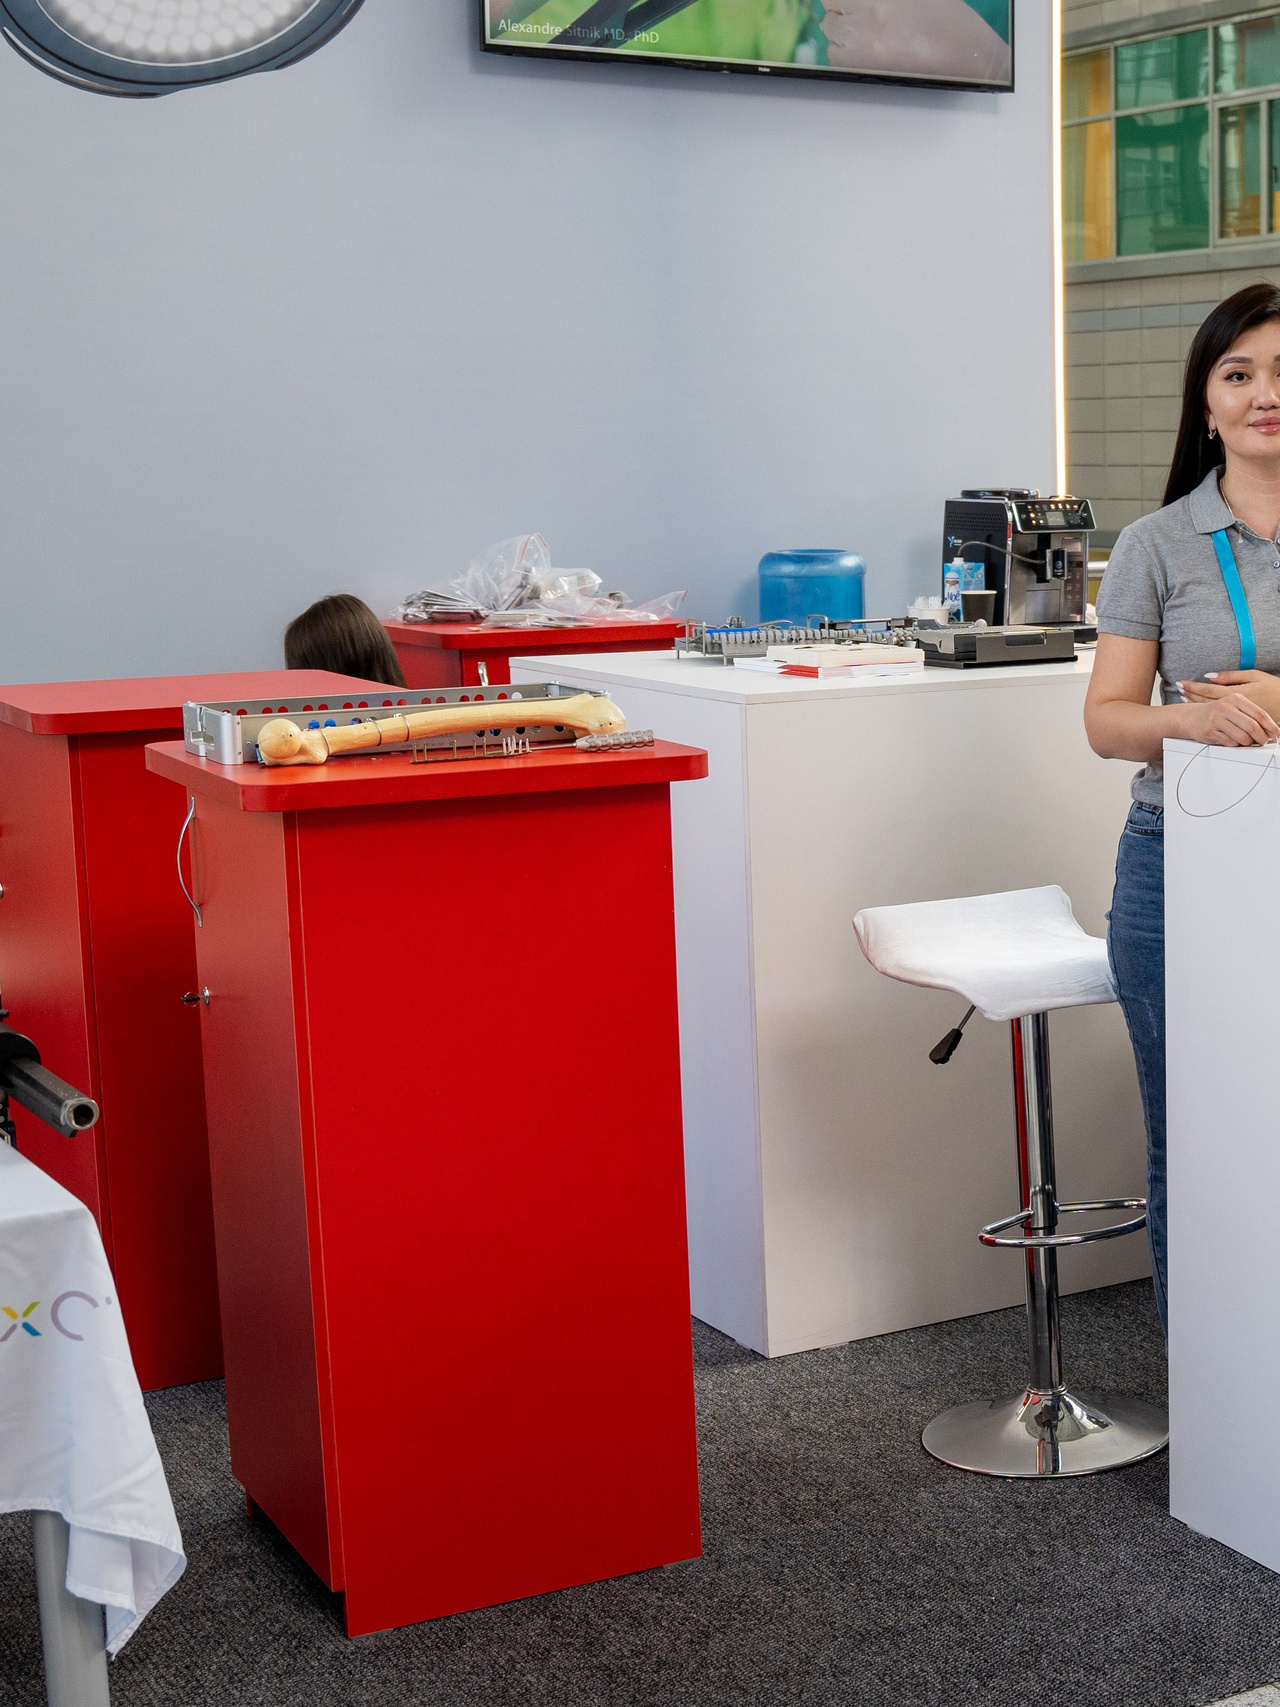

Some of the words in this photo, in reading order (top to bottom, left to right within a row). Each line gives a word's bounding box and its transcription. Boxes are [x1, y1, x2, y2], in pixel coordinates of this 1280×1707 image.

[498, 19, 562, 36] Alexandre
[566, 24, 601, 39] Sitnik
[634, 30, 660, 44] PhD
